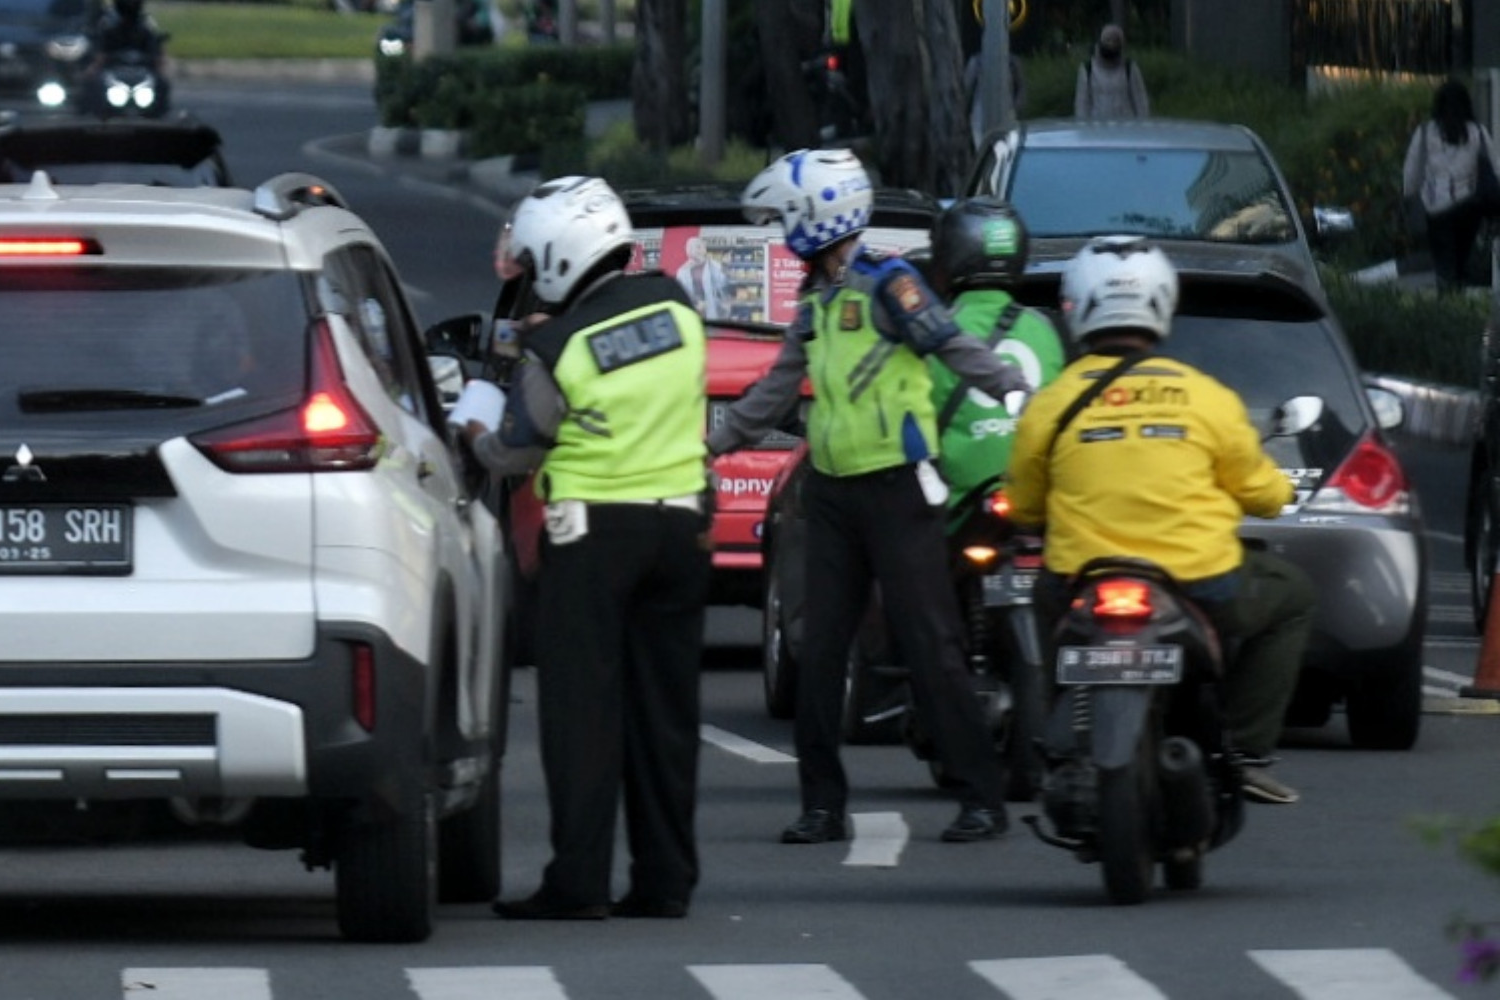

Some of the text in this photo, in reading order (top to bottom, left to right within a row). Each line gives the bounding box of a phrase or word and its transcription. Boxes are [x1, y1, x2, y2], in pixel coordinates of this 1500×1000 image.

[1090, 379, 1190, 407] axim
[970, 419, 1018, 440] goje
[65, 509, 120, 543] SRH
